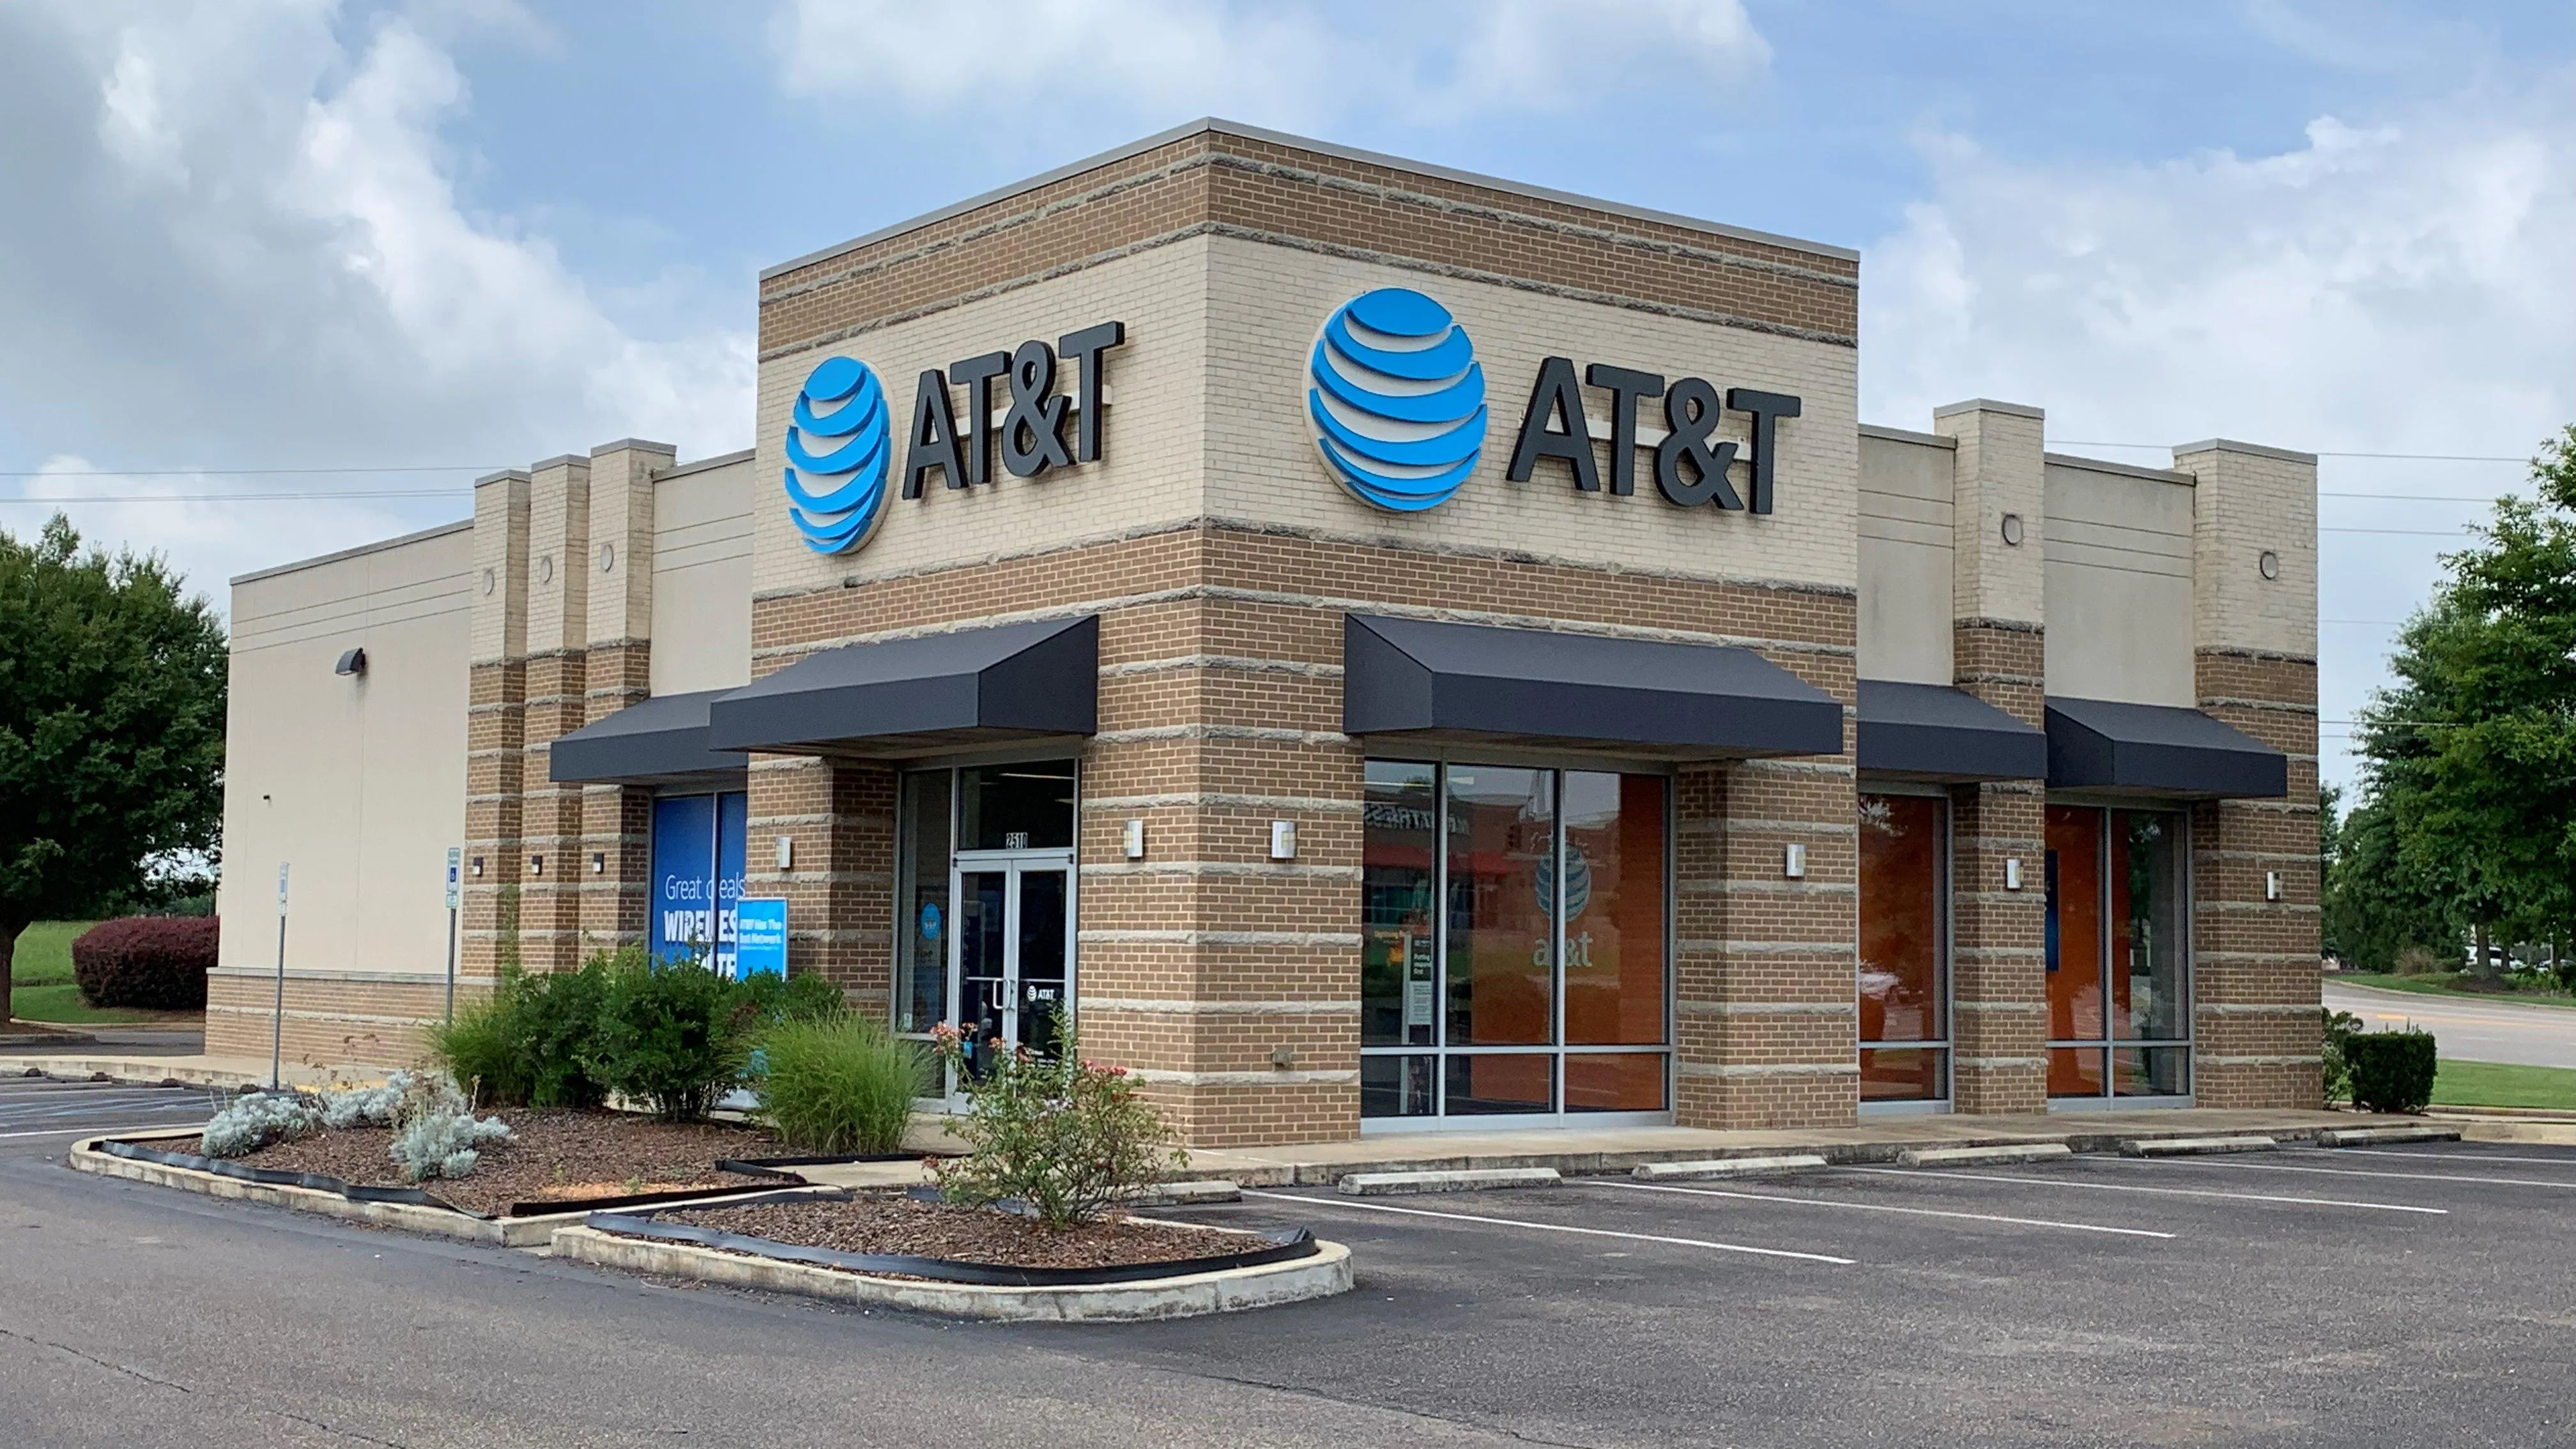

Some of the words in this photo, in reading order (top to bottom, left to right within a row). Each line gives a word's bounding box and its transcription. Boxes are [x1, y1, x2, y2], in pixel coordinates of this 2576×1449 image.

[902, 321, 1125, 500] AT&T
[1506, 356, 1801, 514] AT&T
[666, 875, 702, 900] Great
[664, 909, 736, 942] WIRELES
[1533, 931, 1593, 967] a&t
[1038, 990, 1054, 1000] AT&T
